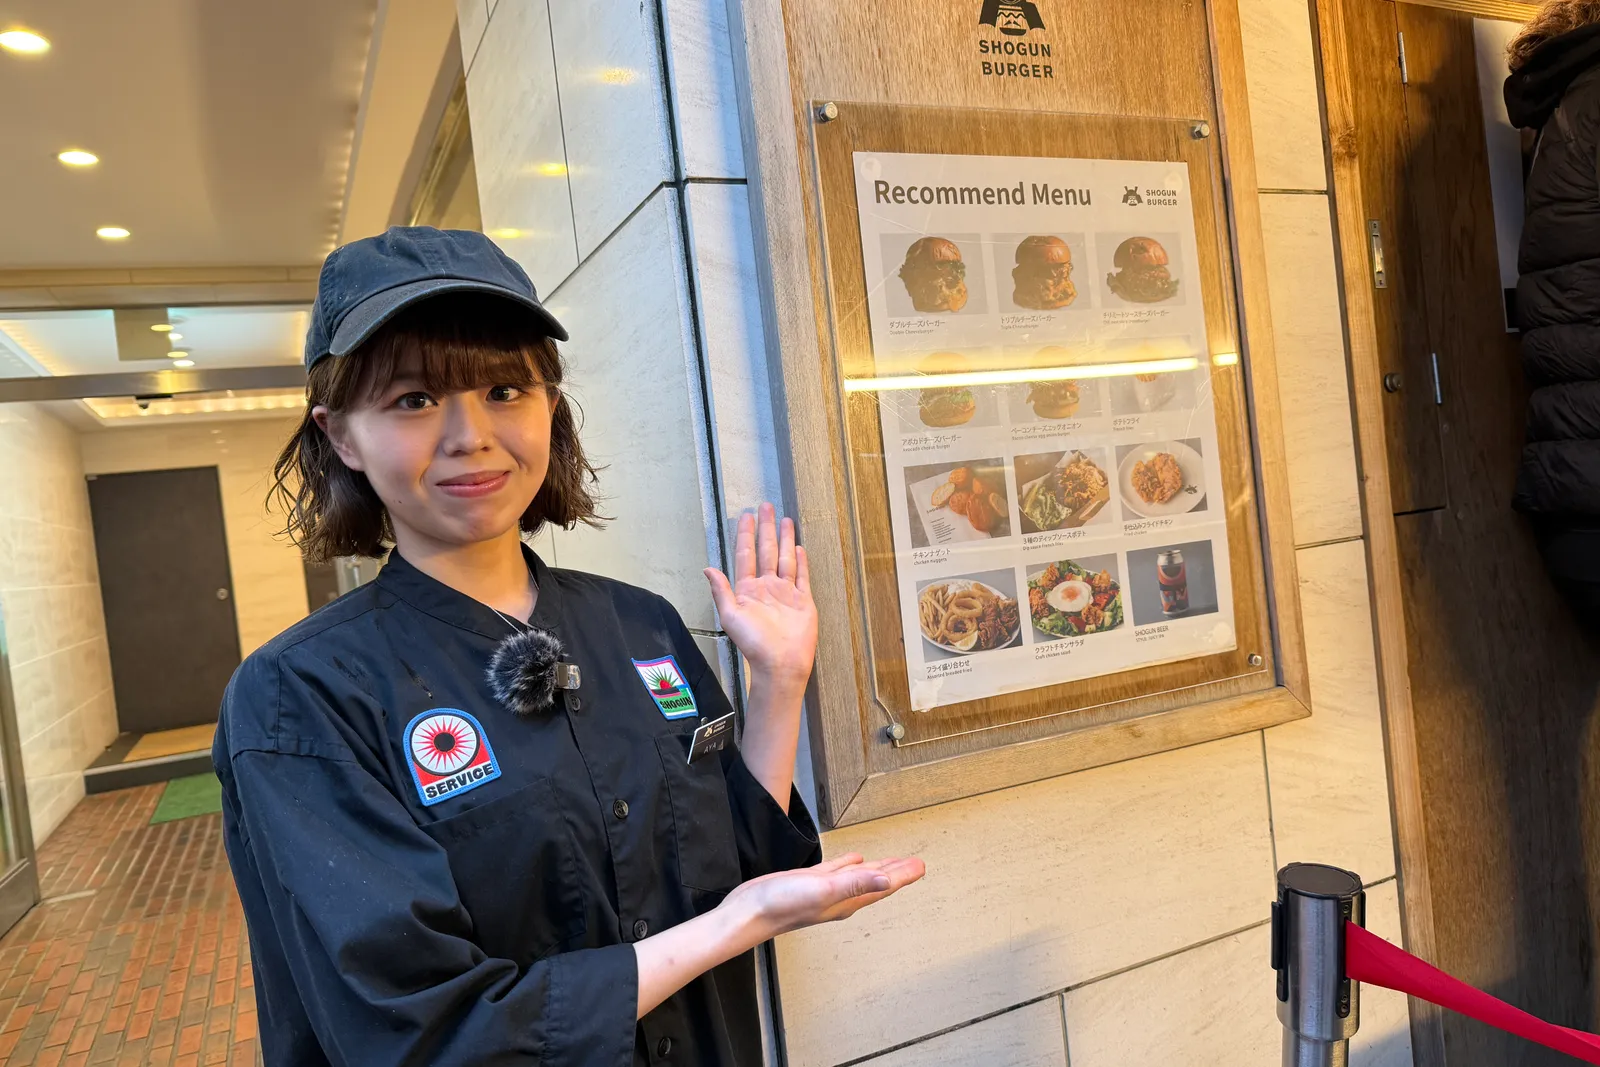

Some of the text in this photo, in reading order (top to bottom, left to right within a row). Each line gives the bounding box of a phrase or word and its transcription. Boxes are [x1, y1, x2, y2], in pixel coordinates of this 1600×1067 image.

[979, 39, 1051, 57] SHOGUN
[981, 61, 1054, 79] BURGER
[874, 180, 1092, 206] Recommend Menu
[1145, 189, 1177, 197] SHOGUN
[889, 320, 946, 329] ダブルチーズバーガー
[912, 548, 951, 560] チキンナゲット
[1134, 625, 1169, 637] SHOGUN BEER
[1034, 638, 1085, 654] クラフトチキンサラダ
[660, 697, 694, 710] SHOGUN
[425, 763, 495, 799] SERVICE
